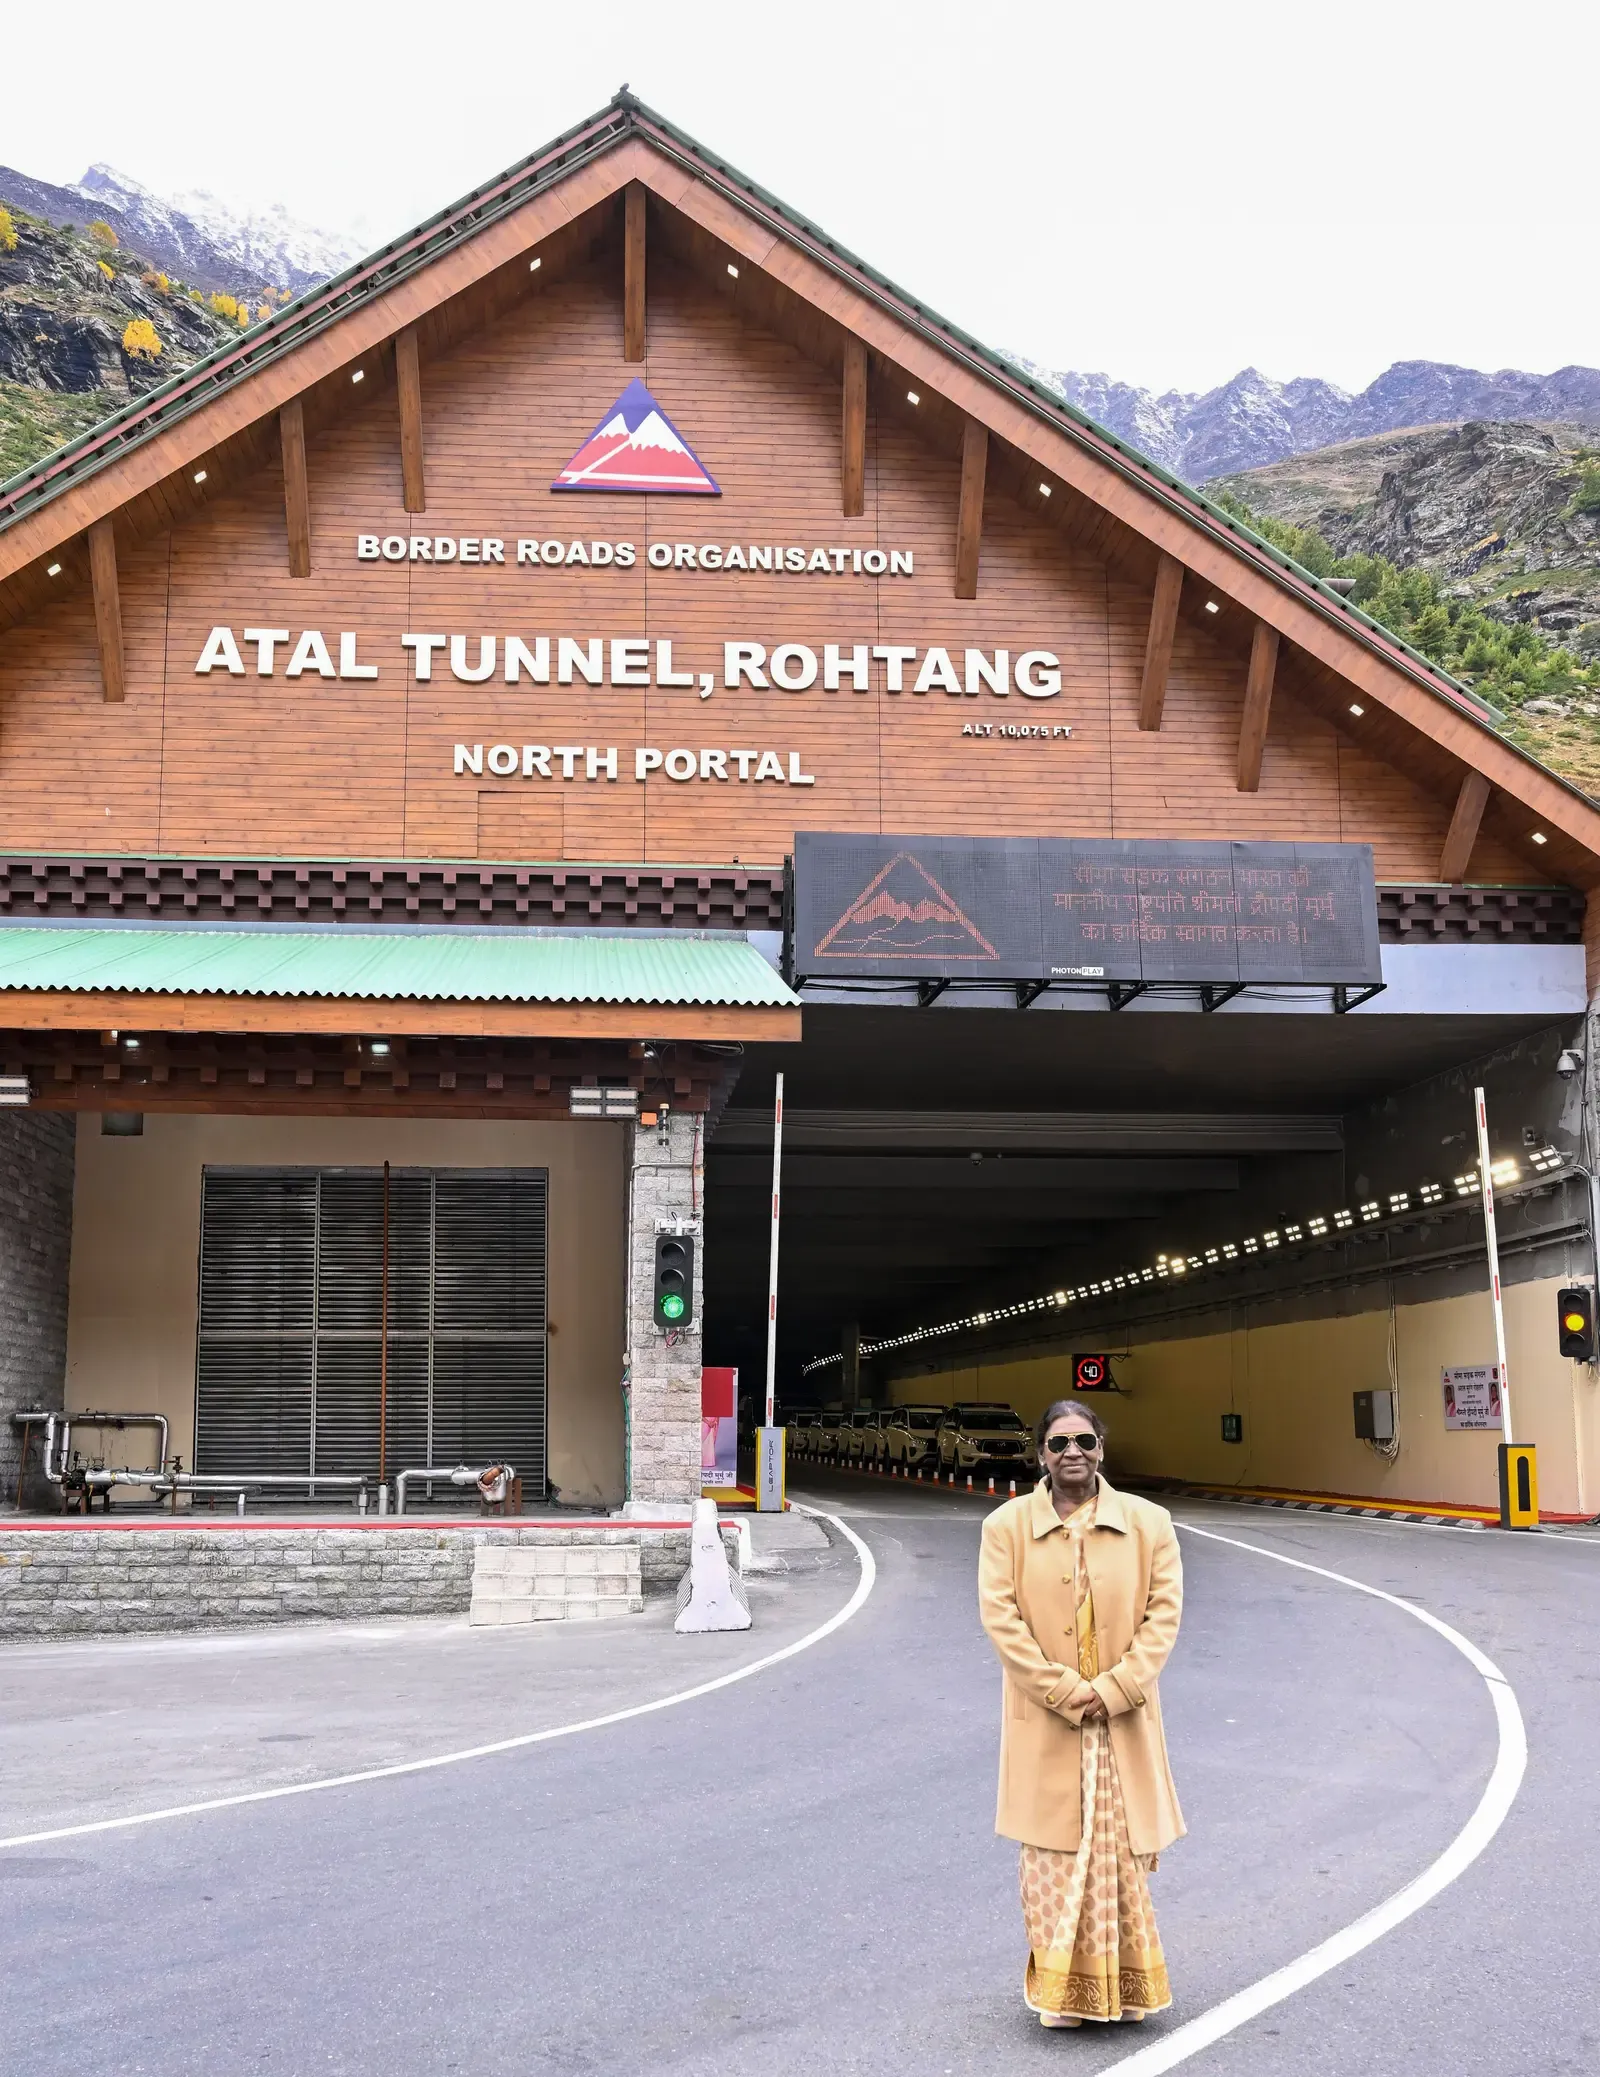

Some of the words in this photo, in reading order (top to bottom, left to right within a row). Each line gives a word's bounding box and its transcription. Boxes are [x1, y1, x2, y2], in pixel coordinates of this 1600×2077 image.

[358, 535, 505, 562] BORDER
[517, 539, 636, 566] ROADS
[648, 543, 914, 577] ORGANISATION
[194, 626, 379, 679] ATAL
[999, 725, 1049, 739] 10,075
[454, 744, 617, 781] NORTH
[635, 748, 815, 786] PORTAL
[1239, 868, 1281, 887] भारत
[1287, 864, 1311, 887] की
[1052, 888, 1119, 912] माननीय
[1191, 889, 1243, 913] श्रीमती
[1080, 922, 1106, 940] का
[1110, 919, 1169, 943] हार्दिक
[1174, 924, 1228, 942] स्वागत
[1232, 925, 1281, 943] करता
[1084, 1365, 1098, 1378] 40
